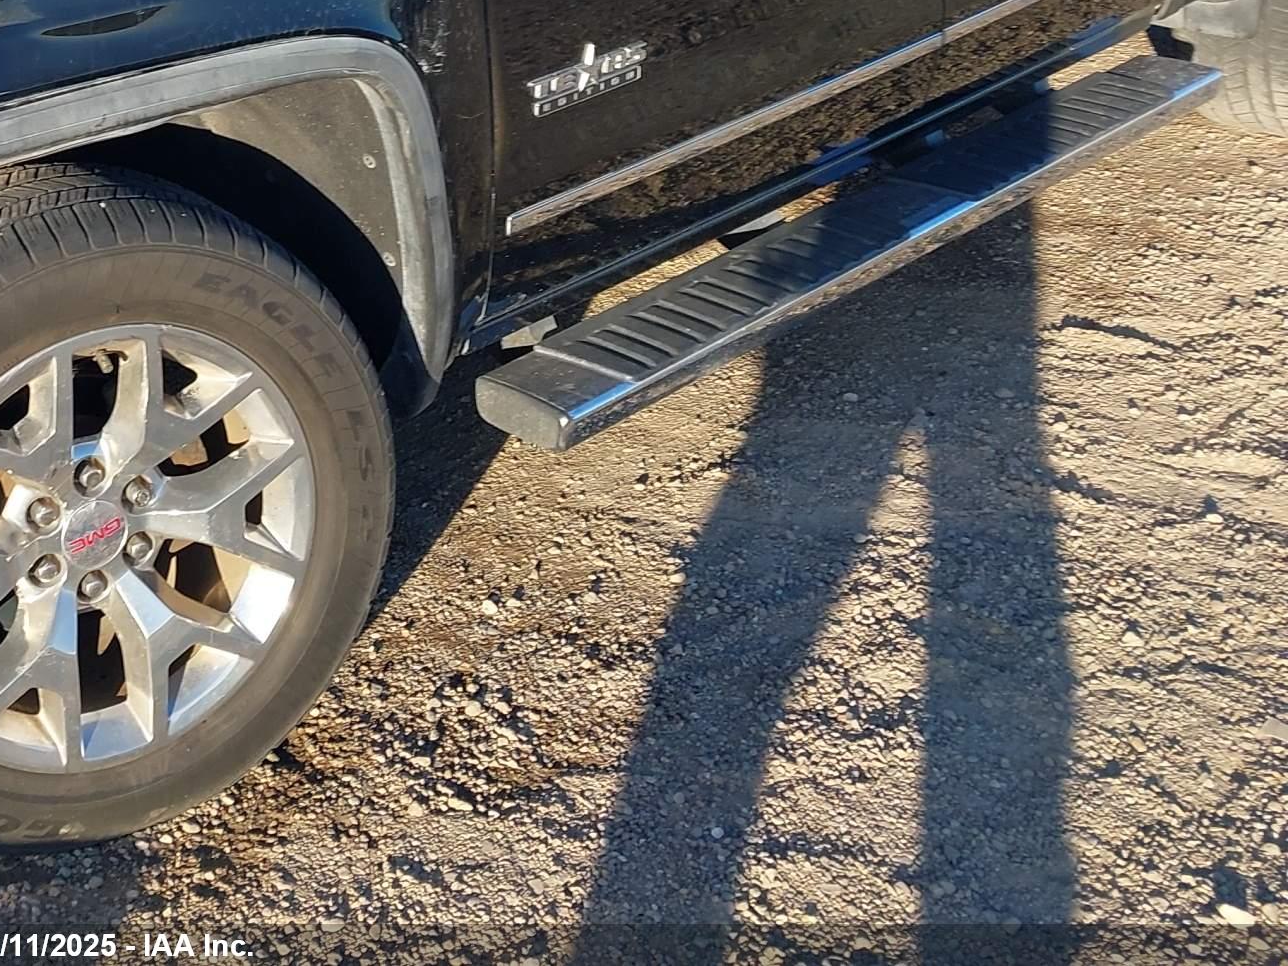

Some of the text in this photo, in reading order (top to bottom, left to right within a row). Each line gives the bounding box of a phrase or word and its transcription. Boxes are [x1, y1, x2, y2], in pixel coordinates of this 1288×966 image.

[526, 41, 649, 99] TEXAS
[541, 69, 636, 113] EDITION
[192, 271, 346, 380] EAGLE
[68, 516, 122, 554] GMC
